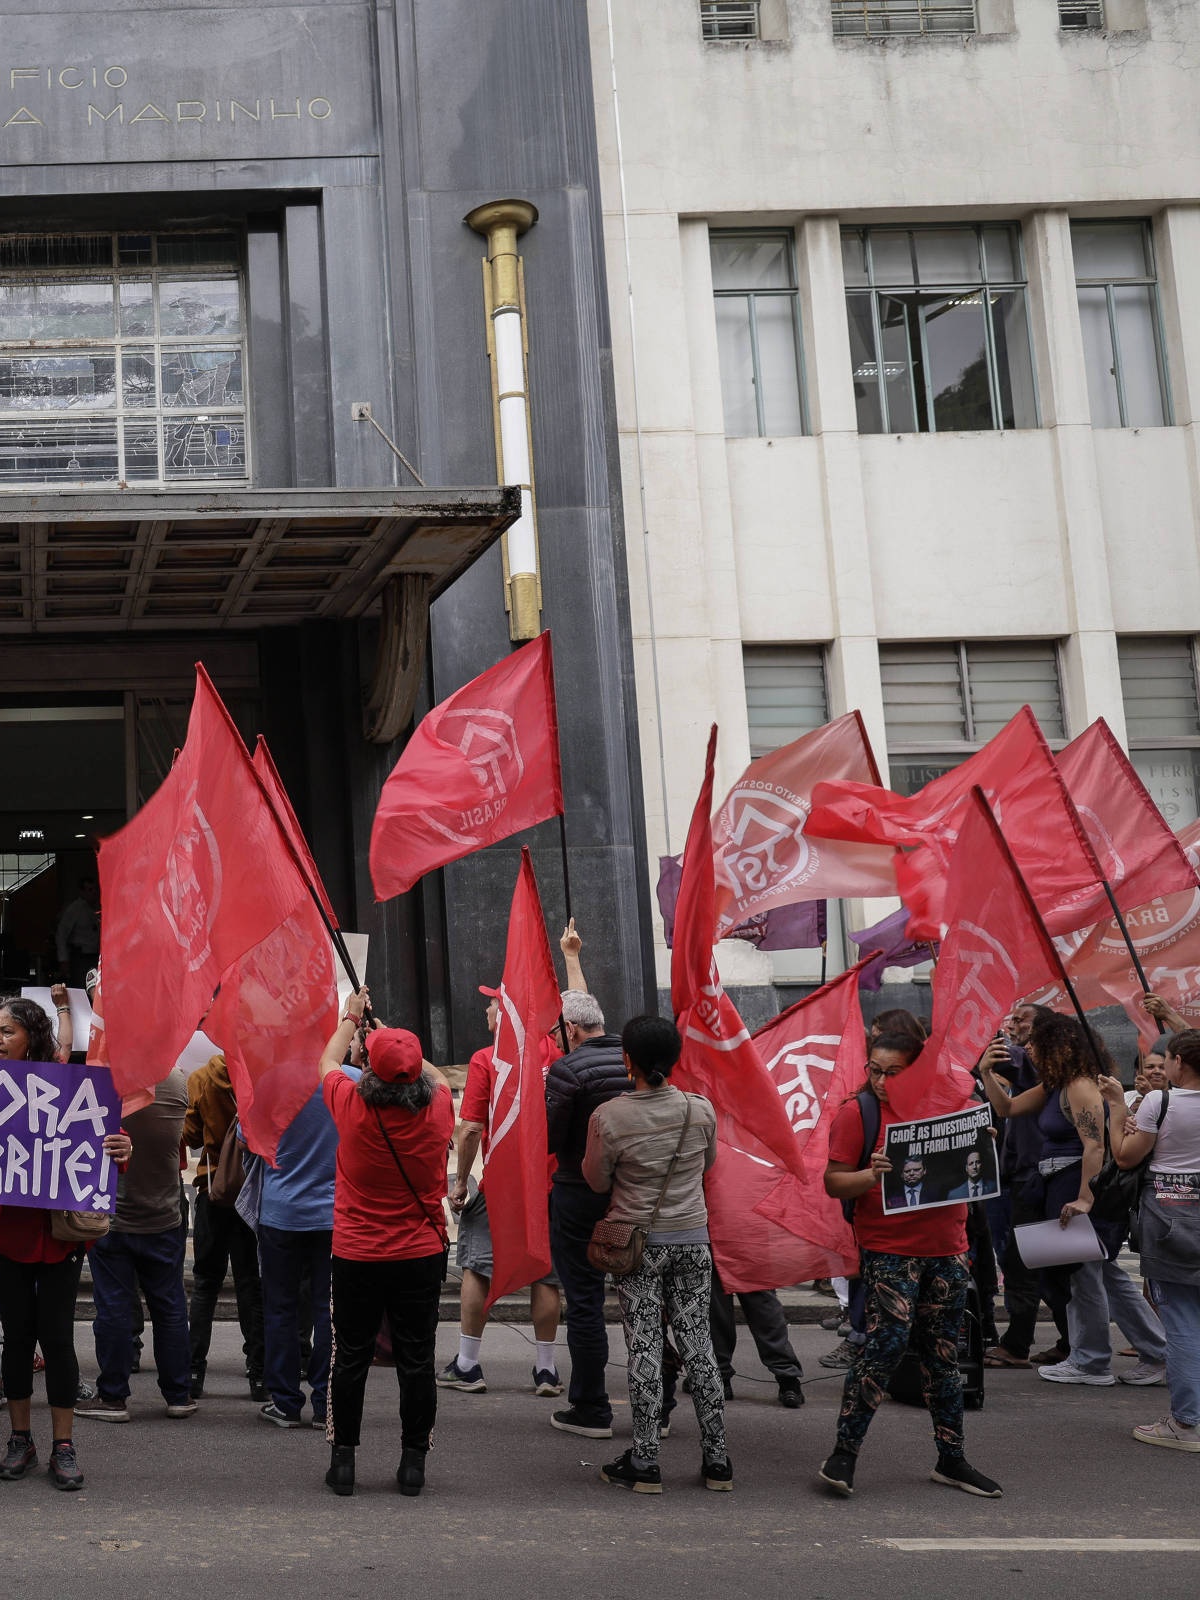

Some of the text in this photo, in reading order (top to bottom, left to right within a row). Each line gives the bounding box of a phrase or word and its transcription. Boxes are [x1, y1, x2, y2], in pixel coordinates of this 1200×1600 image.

[87, 97, 333, 127] MARINHO
[890, 1111, 990, 1143] CADÊ AS INVESTIGAÇÕES
[909, 1130, 978, 1156] NA FARIA LIMA?
